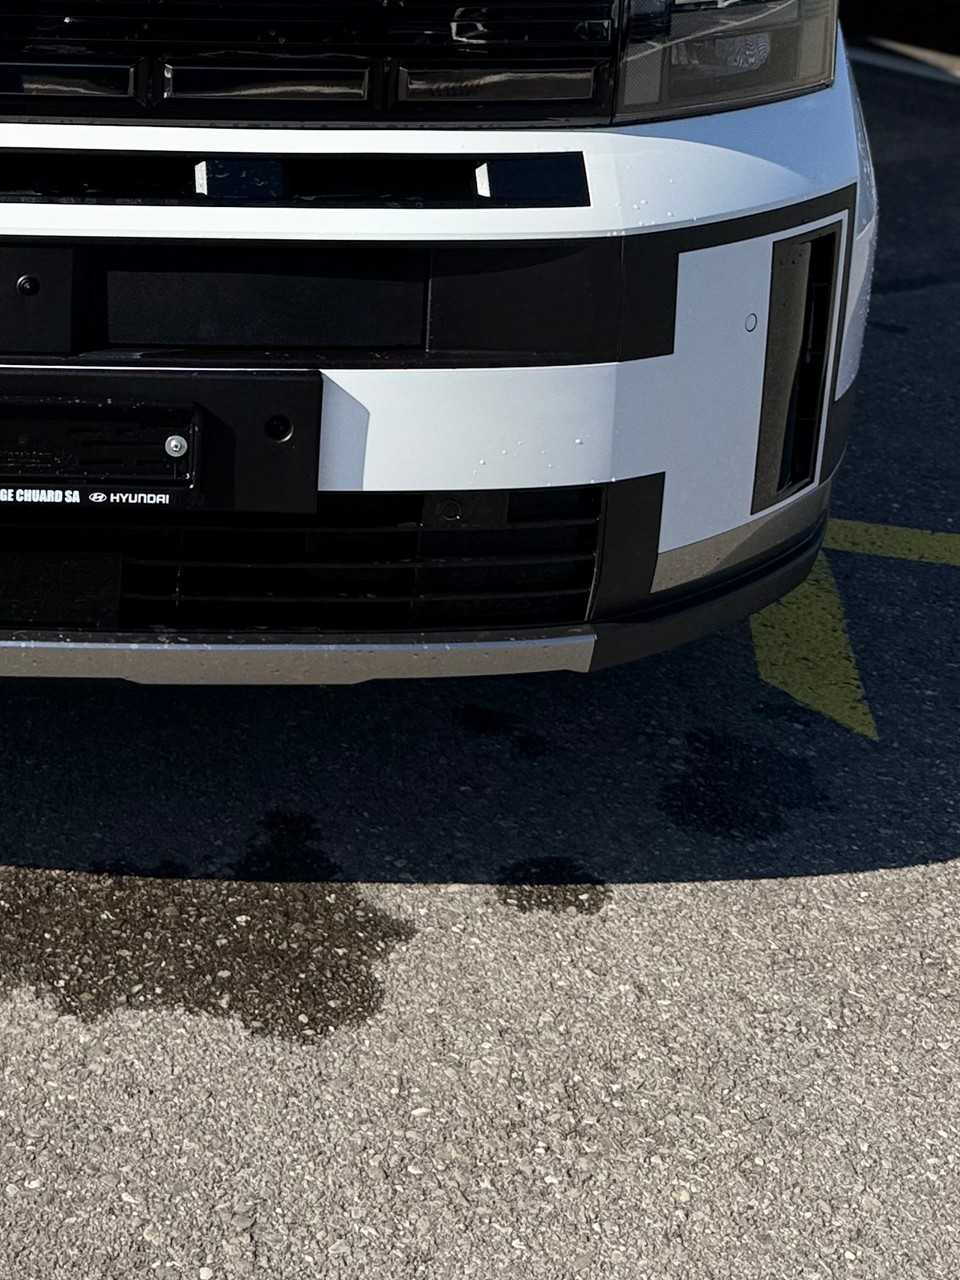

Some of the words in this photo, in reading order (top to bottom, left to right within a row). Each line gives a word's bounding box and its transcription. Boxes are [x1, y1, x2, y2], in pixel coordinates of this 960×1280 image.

[16, 489, 63, 503] CHUARD
[64, 490, 80, 503] SA
[110, 493, 170, 504] HYUNDAI
